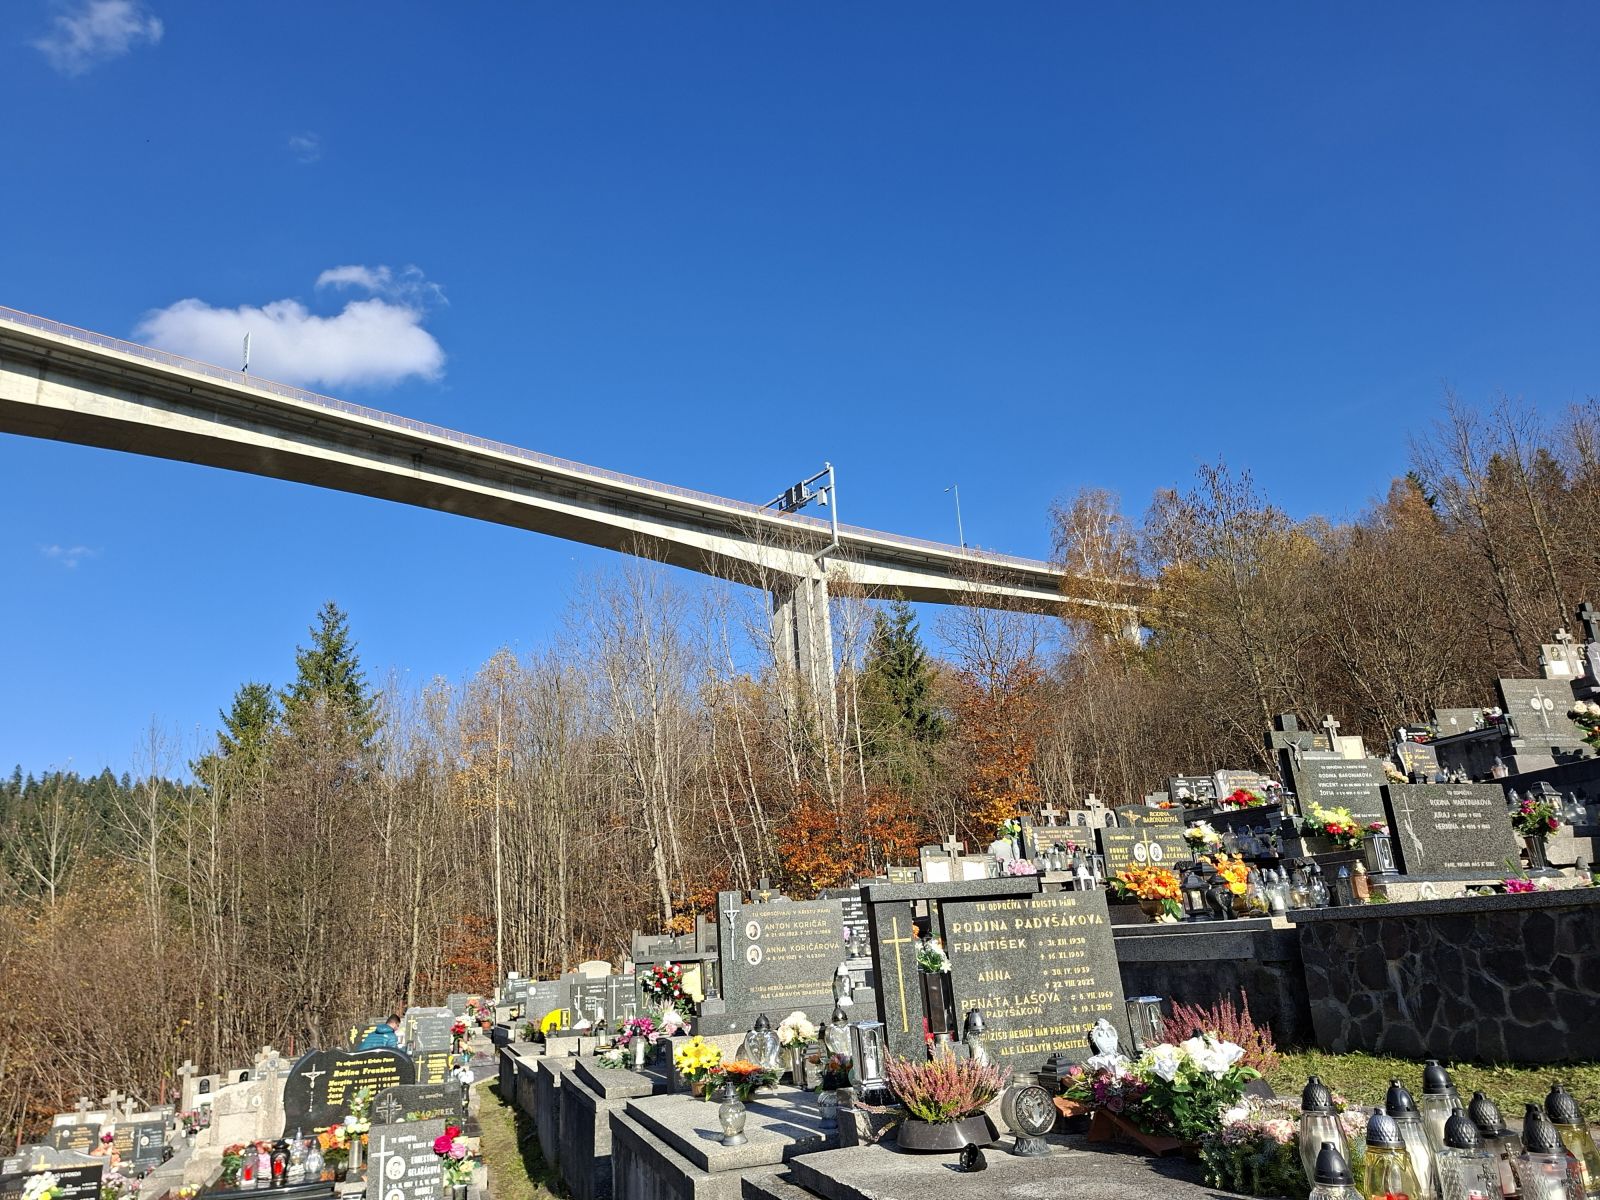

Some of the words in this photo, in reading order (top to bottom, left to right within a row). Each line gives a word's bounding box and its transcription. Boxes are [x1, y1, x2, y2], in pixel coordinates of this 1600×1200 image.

[953, 919, 1008, 933] RODINA
[954, 936, 1027, 953] FRANTIŠEK
[978, 971, 1011, 982] ANNA
[961, 994, 1009, 1010] RENÁTA
[1015, 988, 1060, 1006] LAŠOVÁ
[1001, 1045, 1015, 1056] ALE
